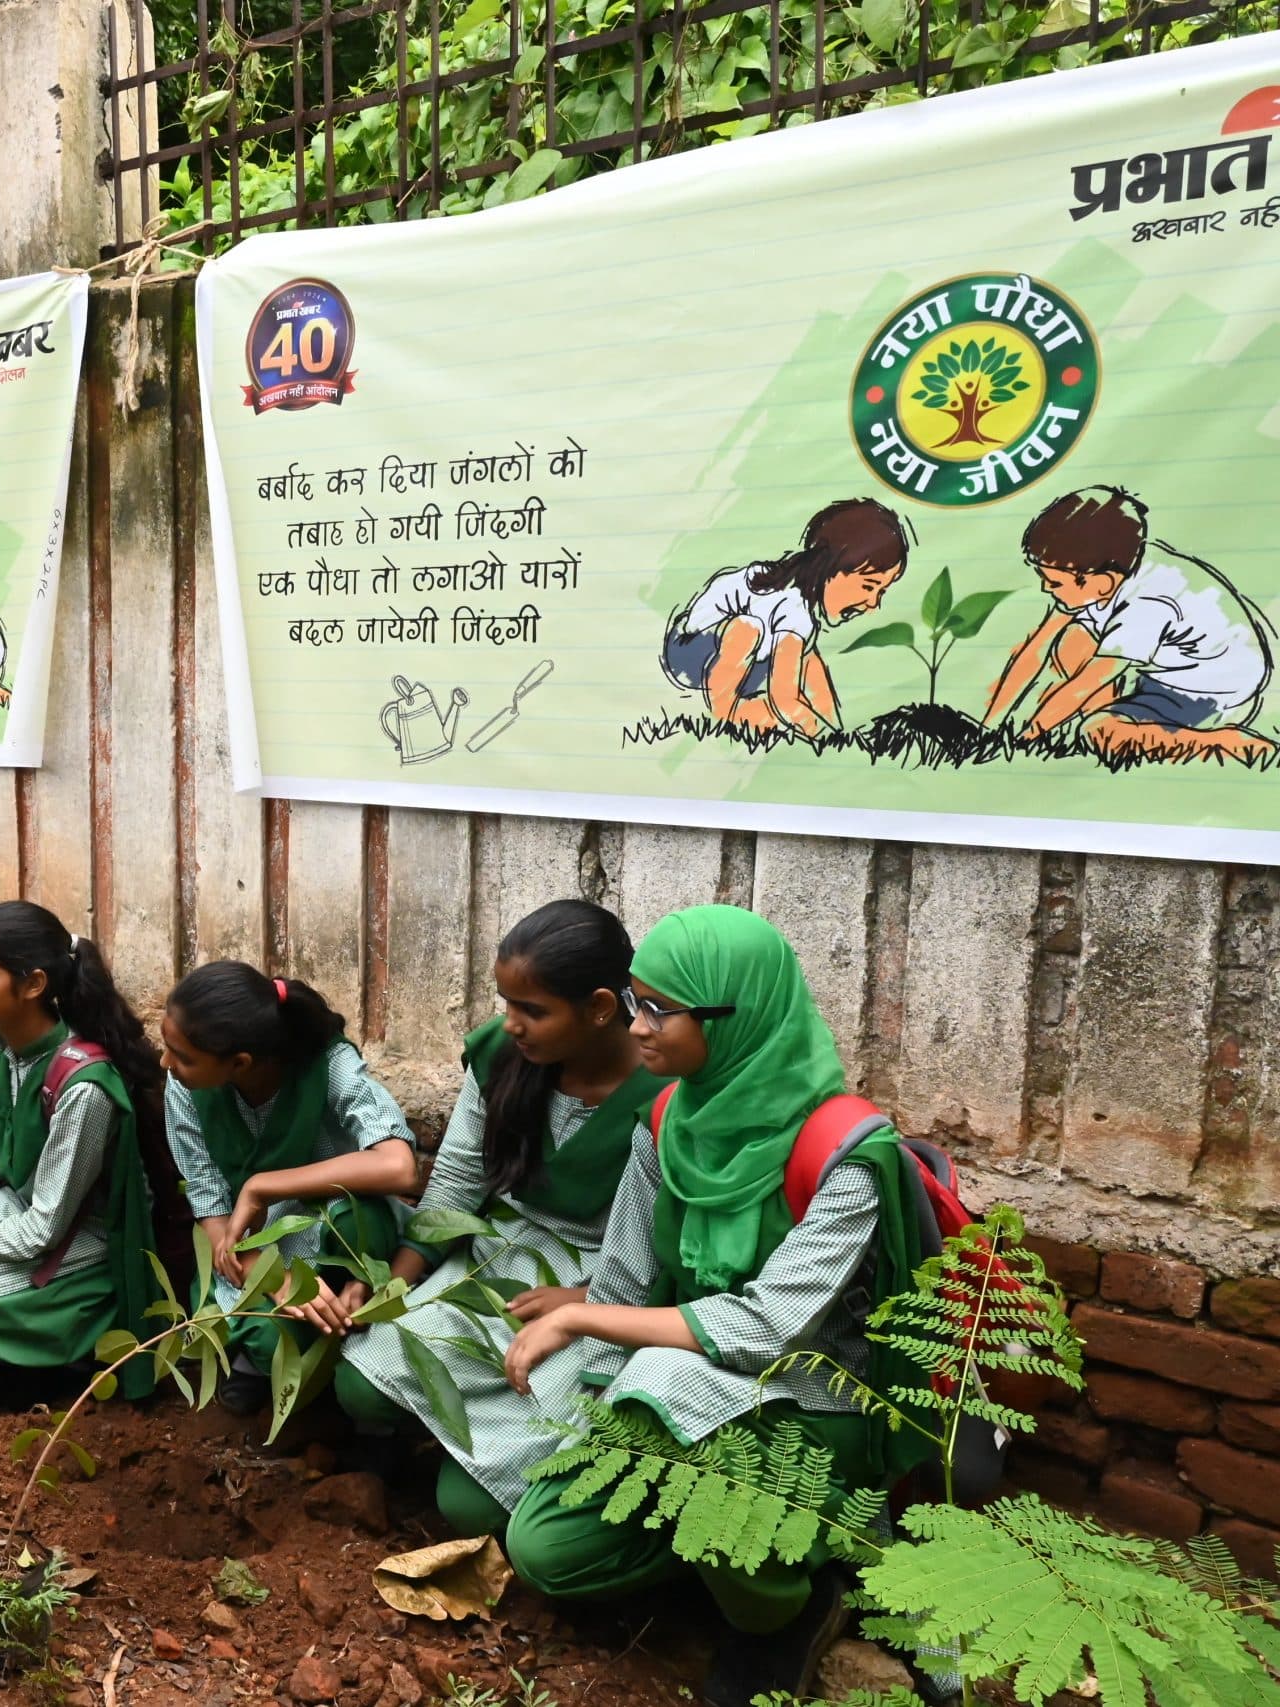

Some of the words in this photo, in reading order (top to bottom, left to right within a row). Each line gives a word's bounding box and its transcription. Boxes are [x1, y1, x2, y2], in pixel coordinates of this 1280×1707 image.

[1069, 134, 1273, 222] प्रभात
[260, 317, 336, 376] 40
[871, 292, 953, 369] नया
[971, 274, 1083, 352] पौधा
[306, 384, 338, 398] आंदोलन
[257, 463, 315, 501] बर्बाद
[326, 468, 367, 495] कर
[378, 455, 438, 493] दिया
[449, 441, 535, 483] जंगलों
[548, 436, 588, 478] को
[870, 418, 939, 493] नया
[959, 402, 1080, 496] जीवन
[287, 520, 344, 548] तबाह
[355, 506, 378, 545] हो
[389, 503, 443, 541] गयी
[455, 496, 547, 539] जिंदगी
[257, 572, 296, 596] एक
[307, 556, 360, 595] पौधा
[371, 555, 400, 594] तो
[411, 550, 508, 592] लगाओ
[520, 546, 582, 590] यारों
[287, 619, 345, 646] बदल
[356, 605, 440, 644] जायेगी
[450, 604, 542, 645] जिंदगी
